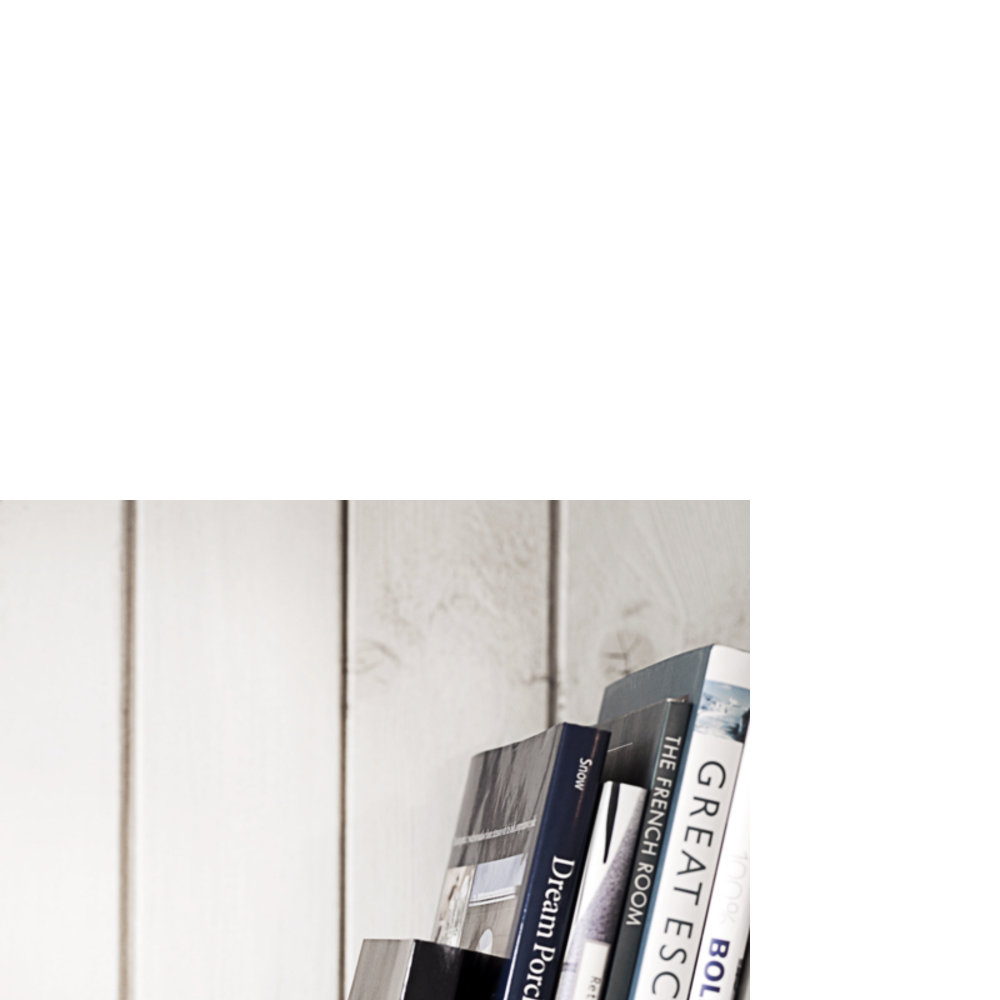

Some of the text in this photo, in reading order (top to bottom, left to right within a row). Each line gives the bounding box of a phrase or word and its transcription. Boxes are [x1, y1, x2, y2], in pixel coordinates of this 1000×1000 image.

[574, 757, 593, 791] Snow
[625, 735, 682, 926] THE FRENCH ROOM
[673, 760, 726, 906] GREAT
[536, 856, 575, 939] Dream
